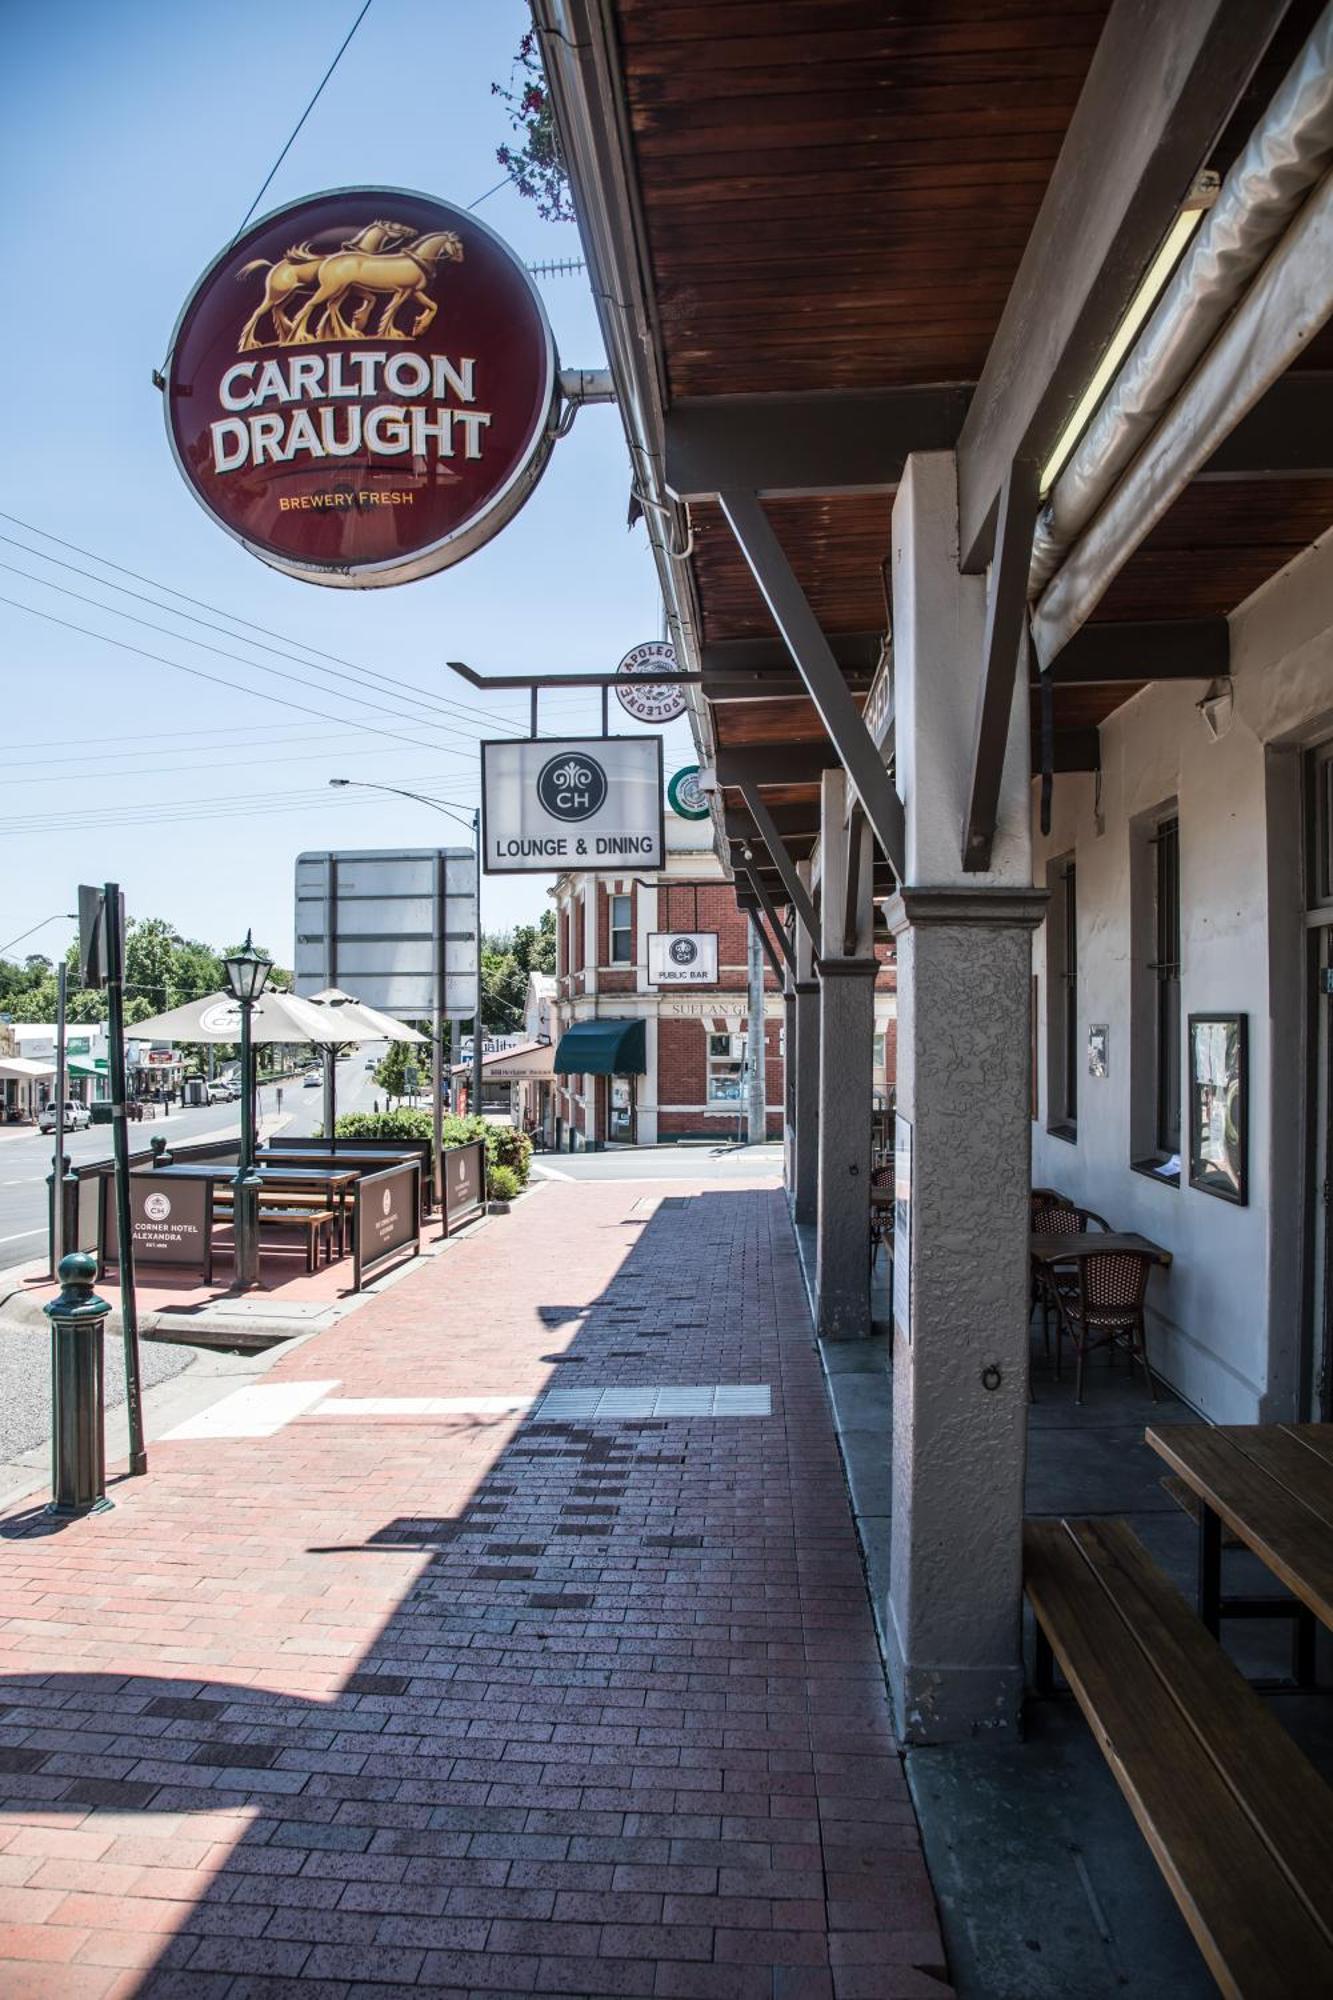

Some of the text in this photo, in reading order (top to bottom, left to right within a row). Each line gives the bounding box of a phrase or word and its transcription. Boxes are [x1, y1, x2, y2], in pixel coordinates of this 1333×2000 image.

[219, 351, 477, 412] CARLTON
[210, 405, 492, 474] DRAUGHT
[279, 491, 414, 511] BREWERY FRESH
[556, 792, 589, 808] CH
[496, 836, 653, 857] LOUNGE & DINING
[658, 971, 688, 979] PUBLIC
[132, 1232, 182, 1241] ALEXANDRA
[134, 1223, 199, 1233] CORNER HOTEL
